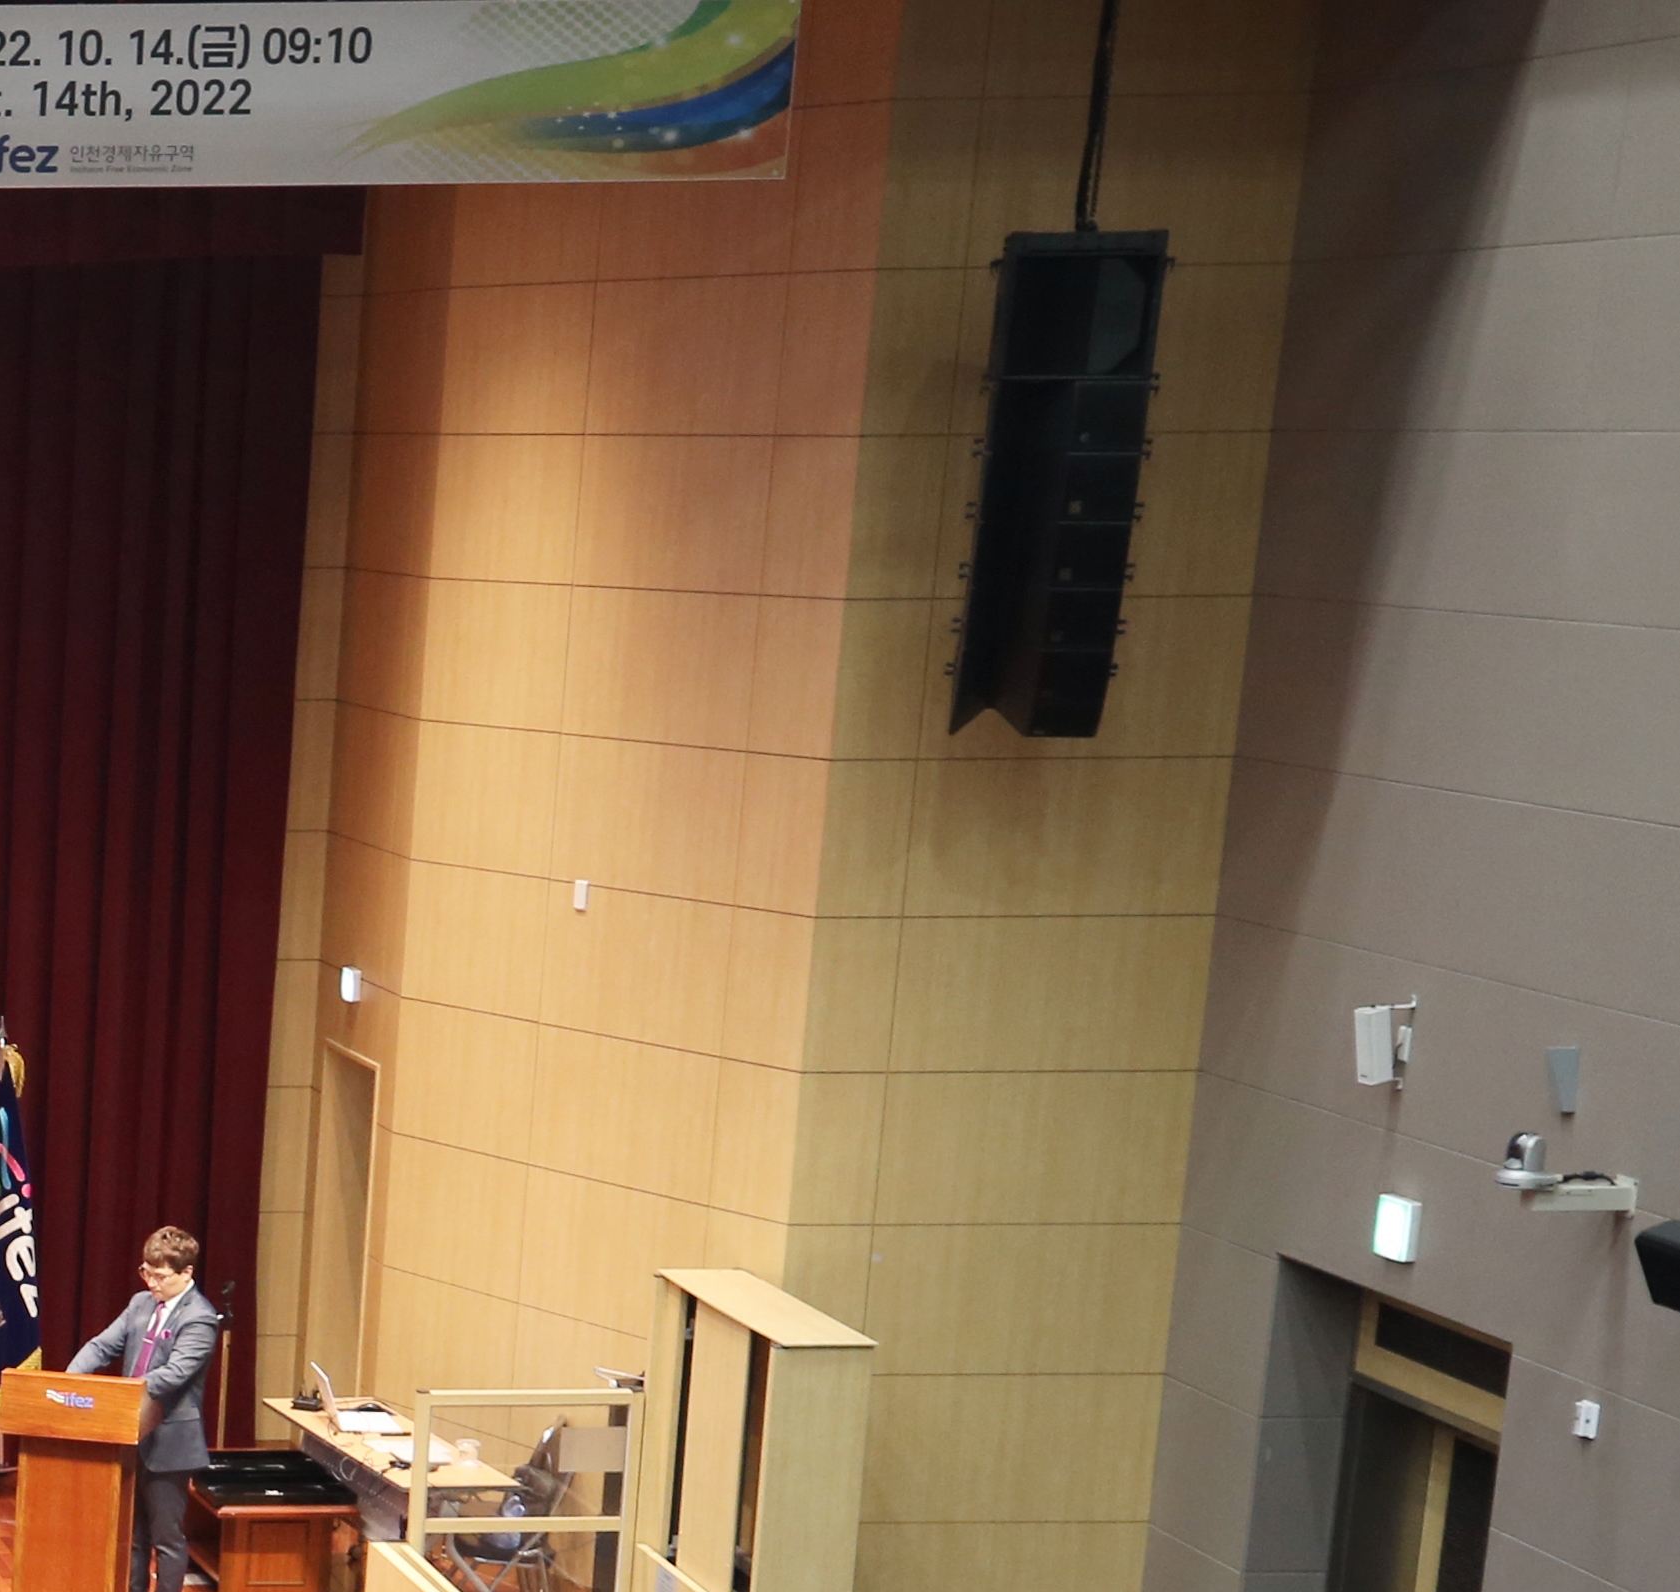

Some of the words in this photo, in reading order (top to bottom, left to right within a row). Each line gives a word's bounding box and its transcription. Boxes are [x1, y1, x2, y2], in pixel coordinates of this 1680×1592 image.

[57, 29, 113, 66] 10.
[262, 26, 373, 66] 09:10
[32, 79, 134, 121] 14th,
[150, 79, 252, 116] 2022
[70, 145, 194, 163] 인천경제자유구역
